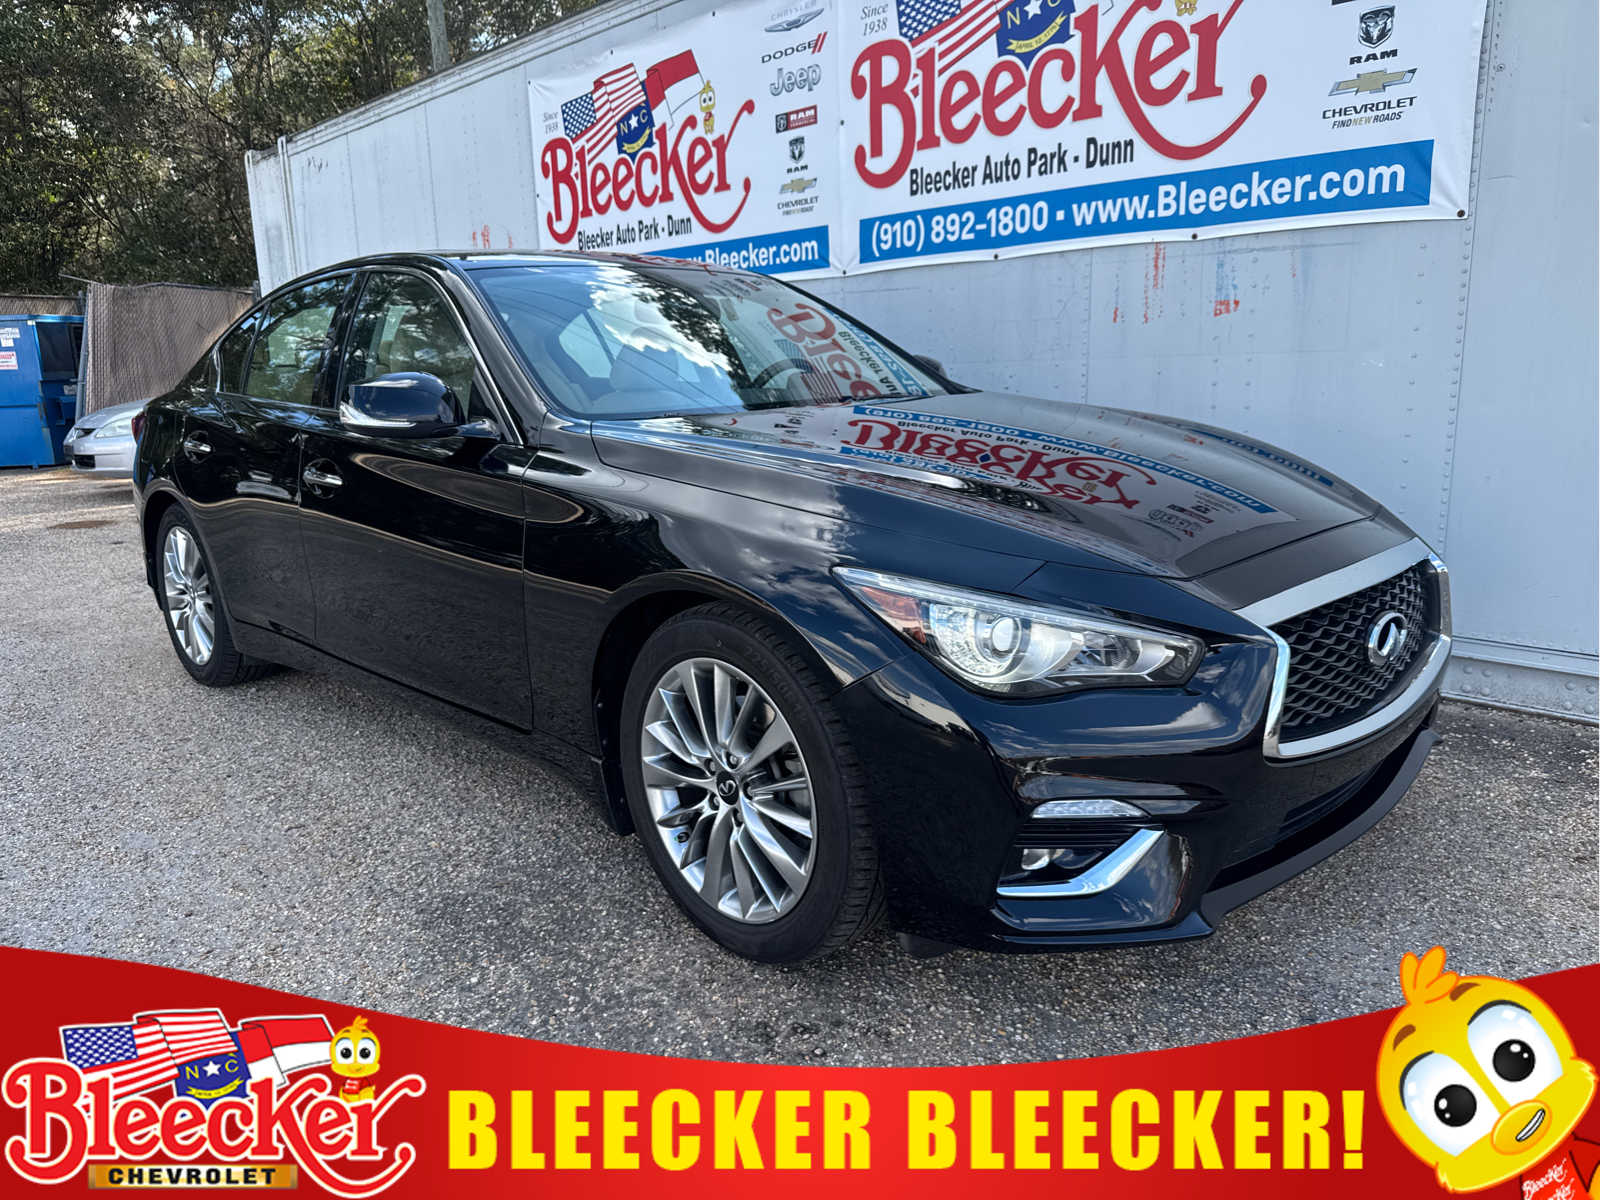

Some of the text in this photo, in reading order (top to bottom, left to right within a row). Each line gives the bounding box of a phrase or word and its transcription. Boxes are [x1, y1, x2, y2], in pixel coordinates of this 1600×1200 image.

[860, 2, 888, 20] Since
[863, 17, 888, 36] 1938
[761, 40, 818, 63] DODGE
[1349, 48, 1398, 65] RAM
[770, 64, 822, 96] Jeep
[850, 0, 1268, 189] Bleecker
[1322, 96, 1418, 119] CHEVROLET
[790, 109, 815, 121] RAM
[541, 99, 755, 244] Bleecker
[786, 165, 808, 174] RAM
[910, 161, 978, 196] Bleecker
[982, 152, 1020, 185] Auto
[1027, 142, 1069, 178] Park
[1086, 136, 1134, 169] Dunn
[871, 162, 1405, 257] (910) 892-1800 www.Bleecker.com
[578, 226, 613, 250] Bleecker
[616, 222, 636, 245] Auto
[638, 216, 660, 241] Park
[667, 214, 692, 237] Dunn
[685, 240, 818, 270] Bleecker.com
